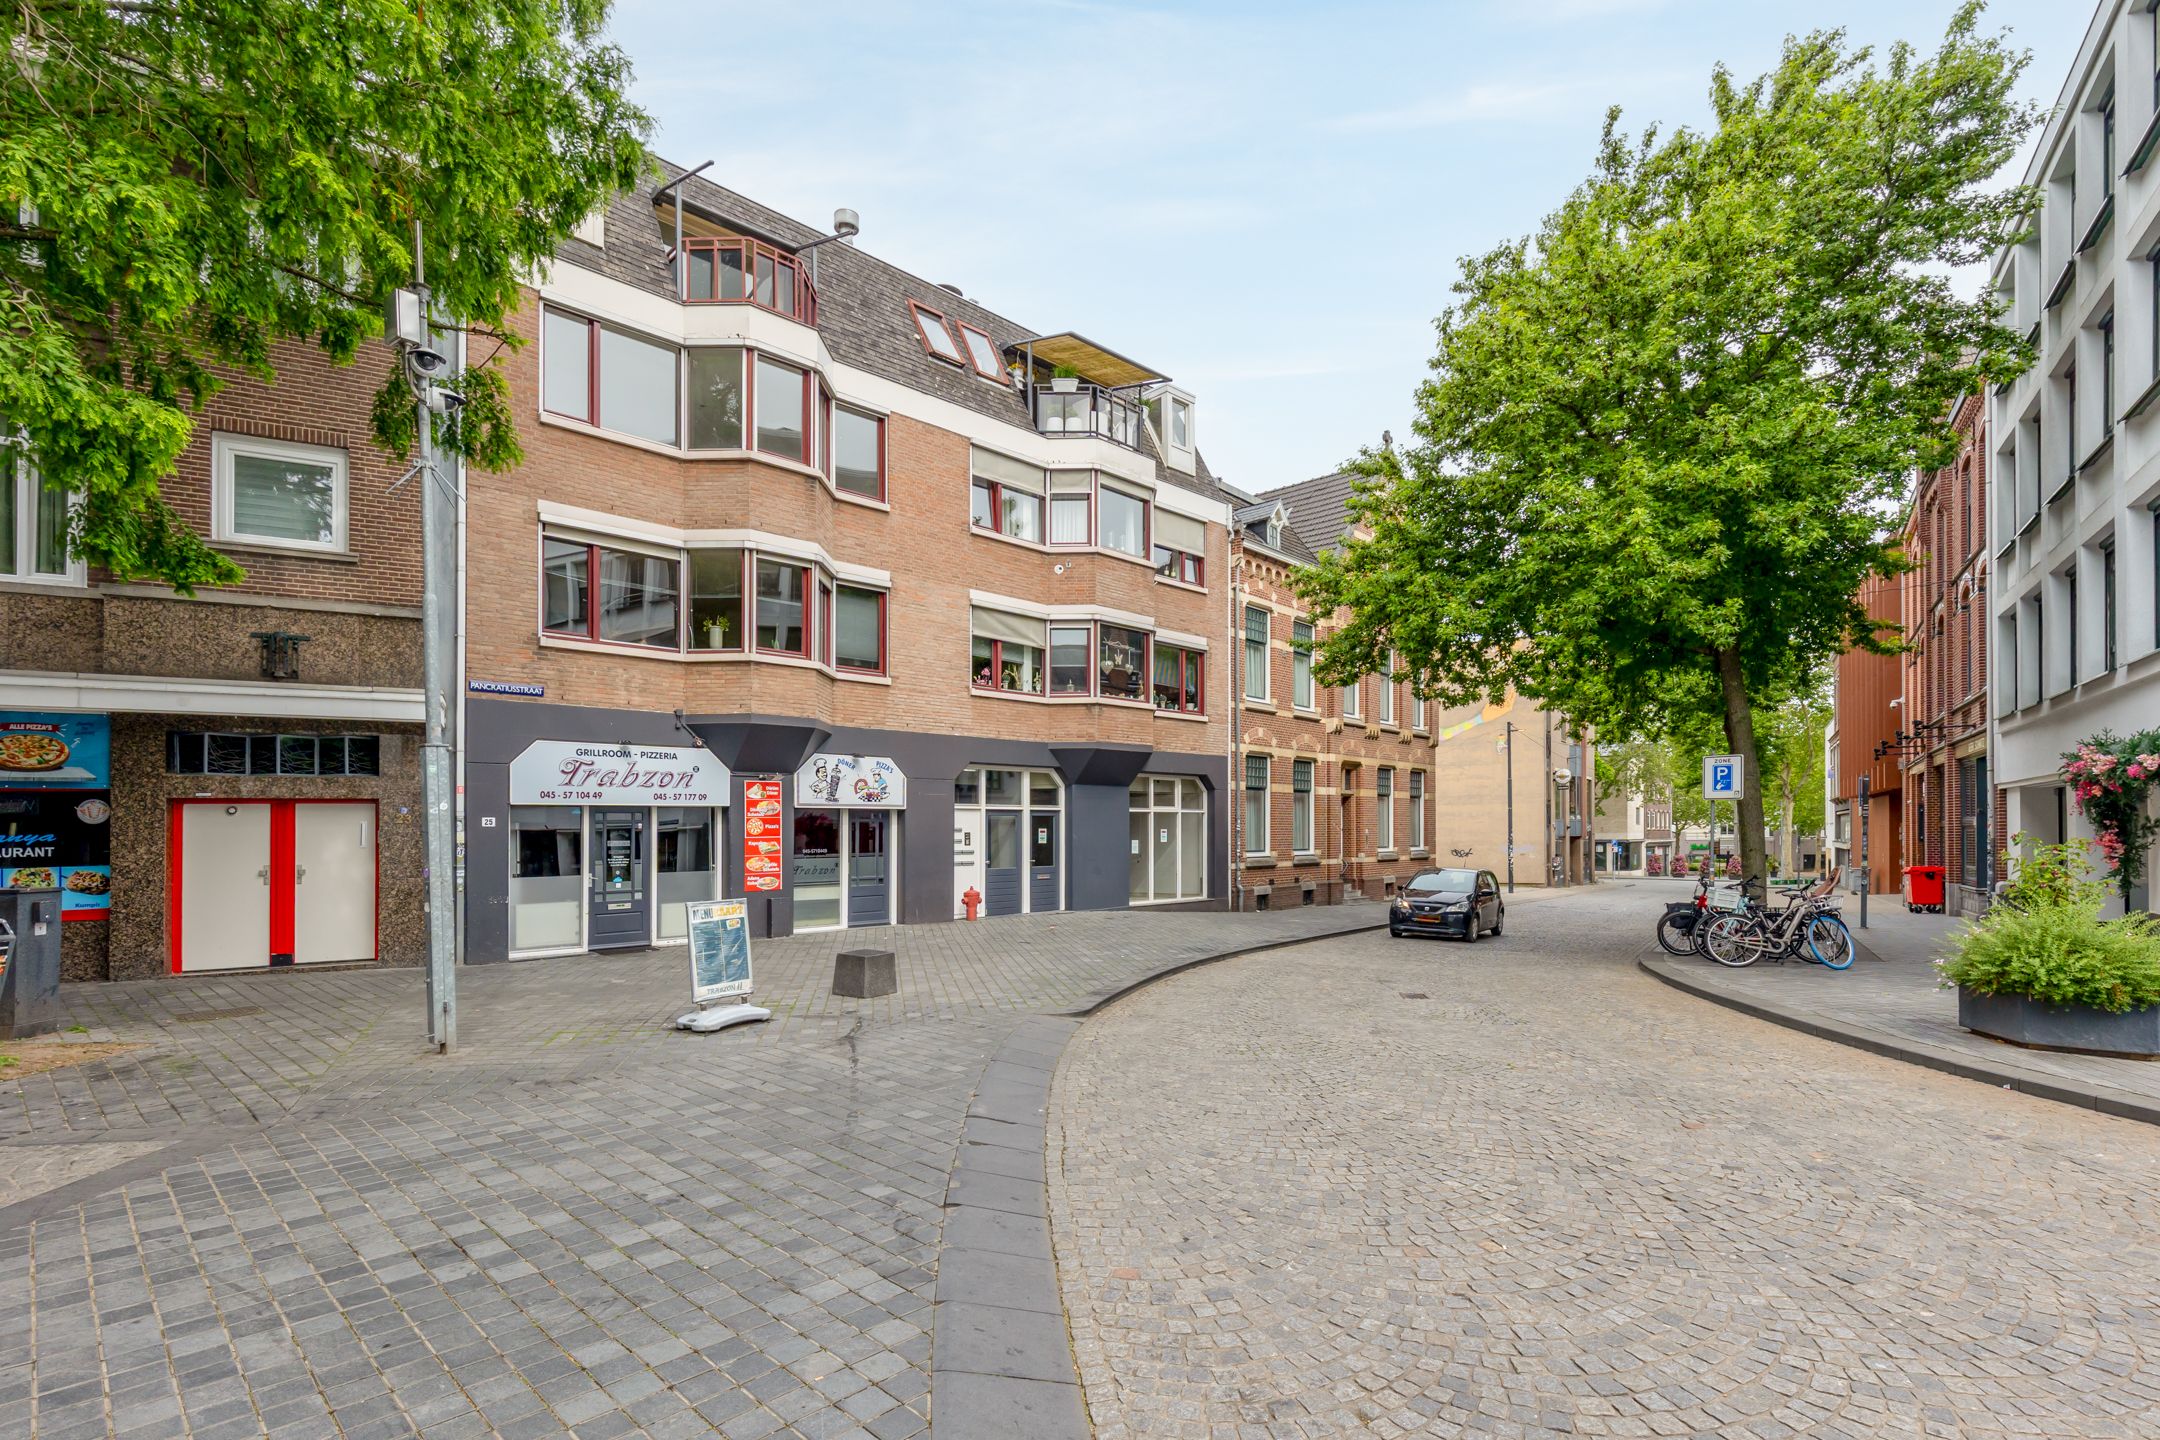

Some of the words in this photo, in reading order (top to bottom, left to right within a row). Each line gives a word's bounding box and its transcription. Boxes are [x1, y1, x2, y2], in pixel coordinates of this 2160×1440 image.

[470, 682, 543, 695] PANCRATIUSSTRAAT
[576, 748, 632, 758] GRILLROOM
[640, 751, 678, 760] PIZZERIA
[837, 758, 856, 770] DÖNER
[875, 760, 894, 774] PIZZA'S
[557, 757, 695, 789] Trabzon
[1716, 766, 1728, 781] P
[540, 790, 556, 799] 045
[562, 791, 573, 799] 57
[576, 791, 590, 799] 104
[592, 791, 603, 800] 49
[653, 793, 667, 801] 045
[673, 793, 682, 801] 57
[684, 793, 696, 801] 177
[698, 793, 708, 801] 09
[484, 818, 494, 826] 25
[0, 846, 55, 858] URANT
